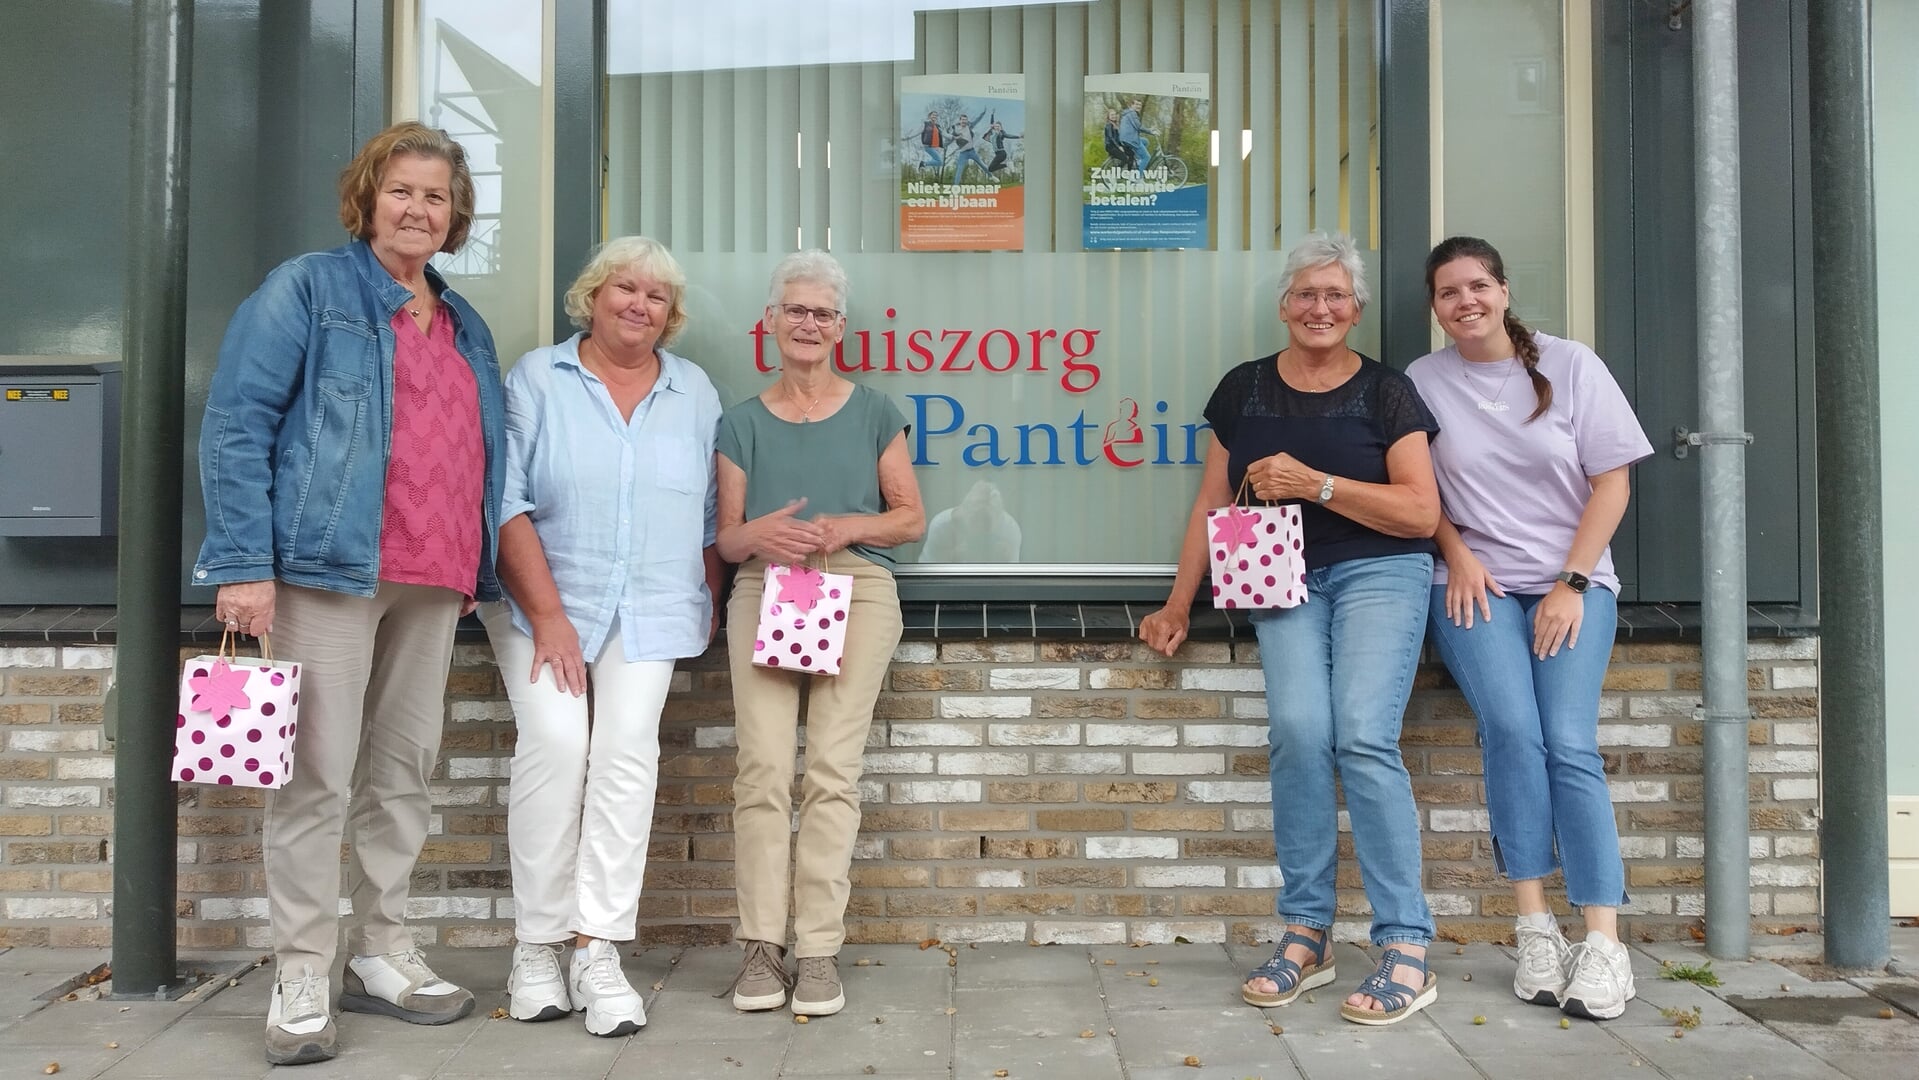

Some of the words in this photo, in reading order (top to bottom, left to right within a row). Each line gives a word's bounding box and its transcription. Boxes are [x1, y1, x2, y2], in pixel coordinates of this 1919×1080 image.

[988, 85, 1018, 94] Pantein
[1090, 167, 1141, 180] Zullen
[1143, 166, 1168, 182] wij
[907, 182, 940, 195] Niet
[942, 183, 1001, 195] zomaar
[1090, 180, 1104, 194] je
[1104, 180, 1175, 193] vakantie
[907, 197, 936, 208] een
[939, 195, 997, 210] bijbaan
[1090, 194, 1157, 206] betalen?
[748, 308, 1102, 393] tuiszorg
